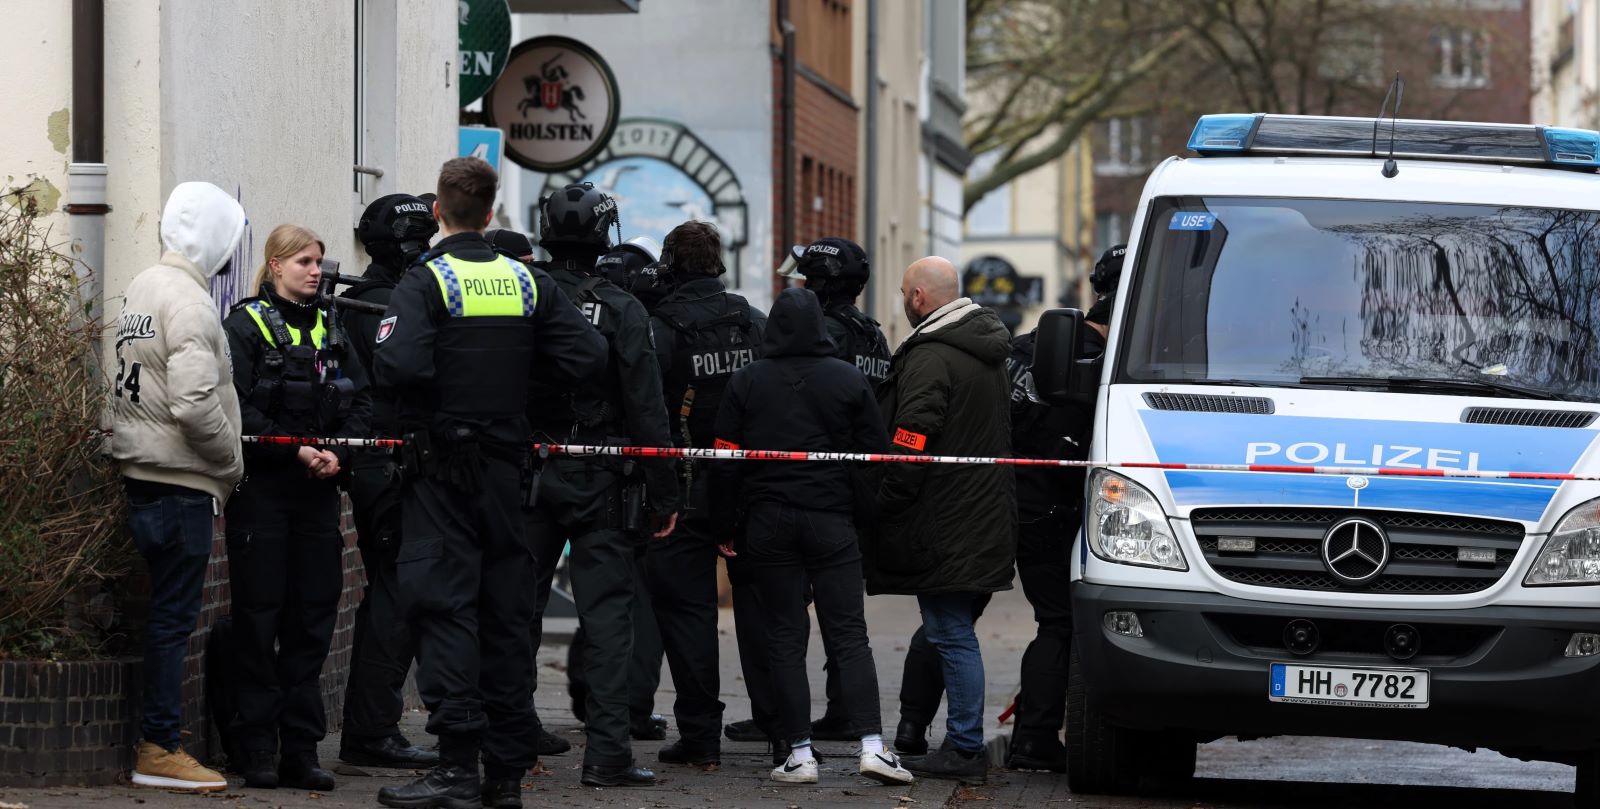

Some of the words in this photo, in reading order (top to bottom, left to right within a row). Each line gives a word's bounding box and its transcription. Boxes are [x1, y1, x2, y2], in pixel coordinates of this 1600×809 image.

[510, 122, 594, 140] HOLSTEN
[394, 202, 429, 214] POLIZEI
[1181, 215, 1205, 227] USE
[807, 244, 840, 256] POLIZEI
[463, 278, 517, 296] POLIZEI
[581, 302, 602, 326] EI
[692, 348, 753, 377] POLIZEI
[115, 357, 142, 403] 24
[1245, 442, 1479, 472] POLIZEI
[1275, 683, 1281, 691] D
[1299, 669, 1332, 695] HH
[1352, 673, 1416, 699] 7782
